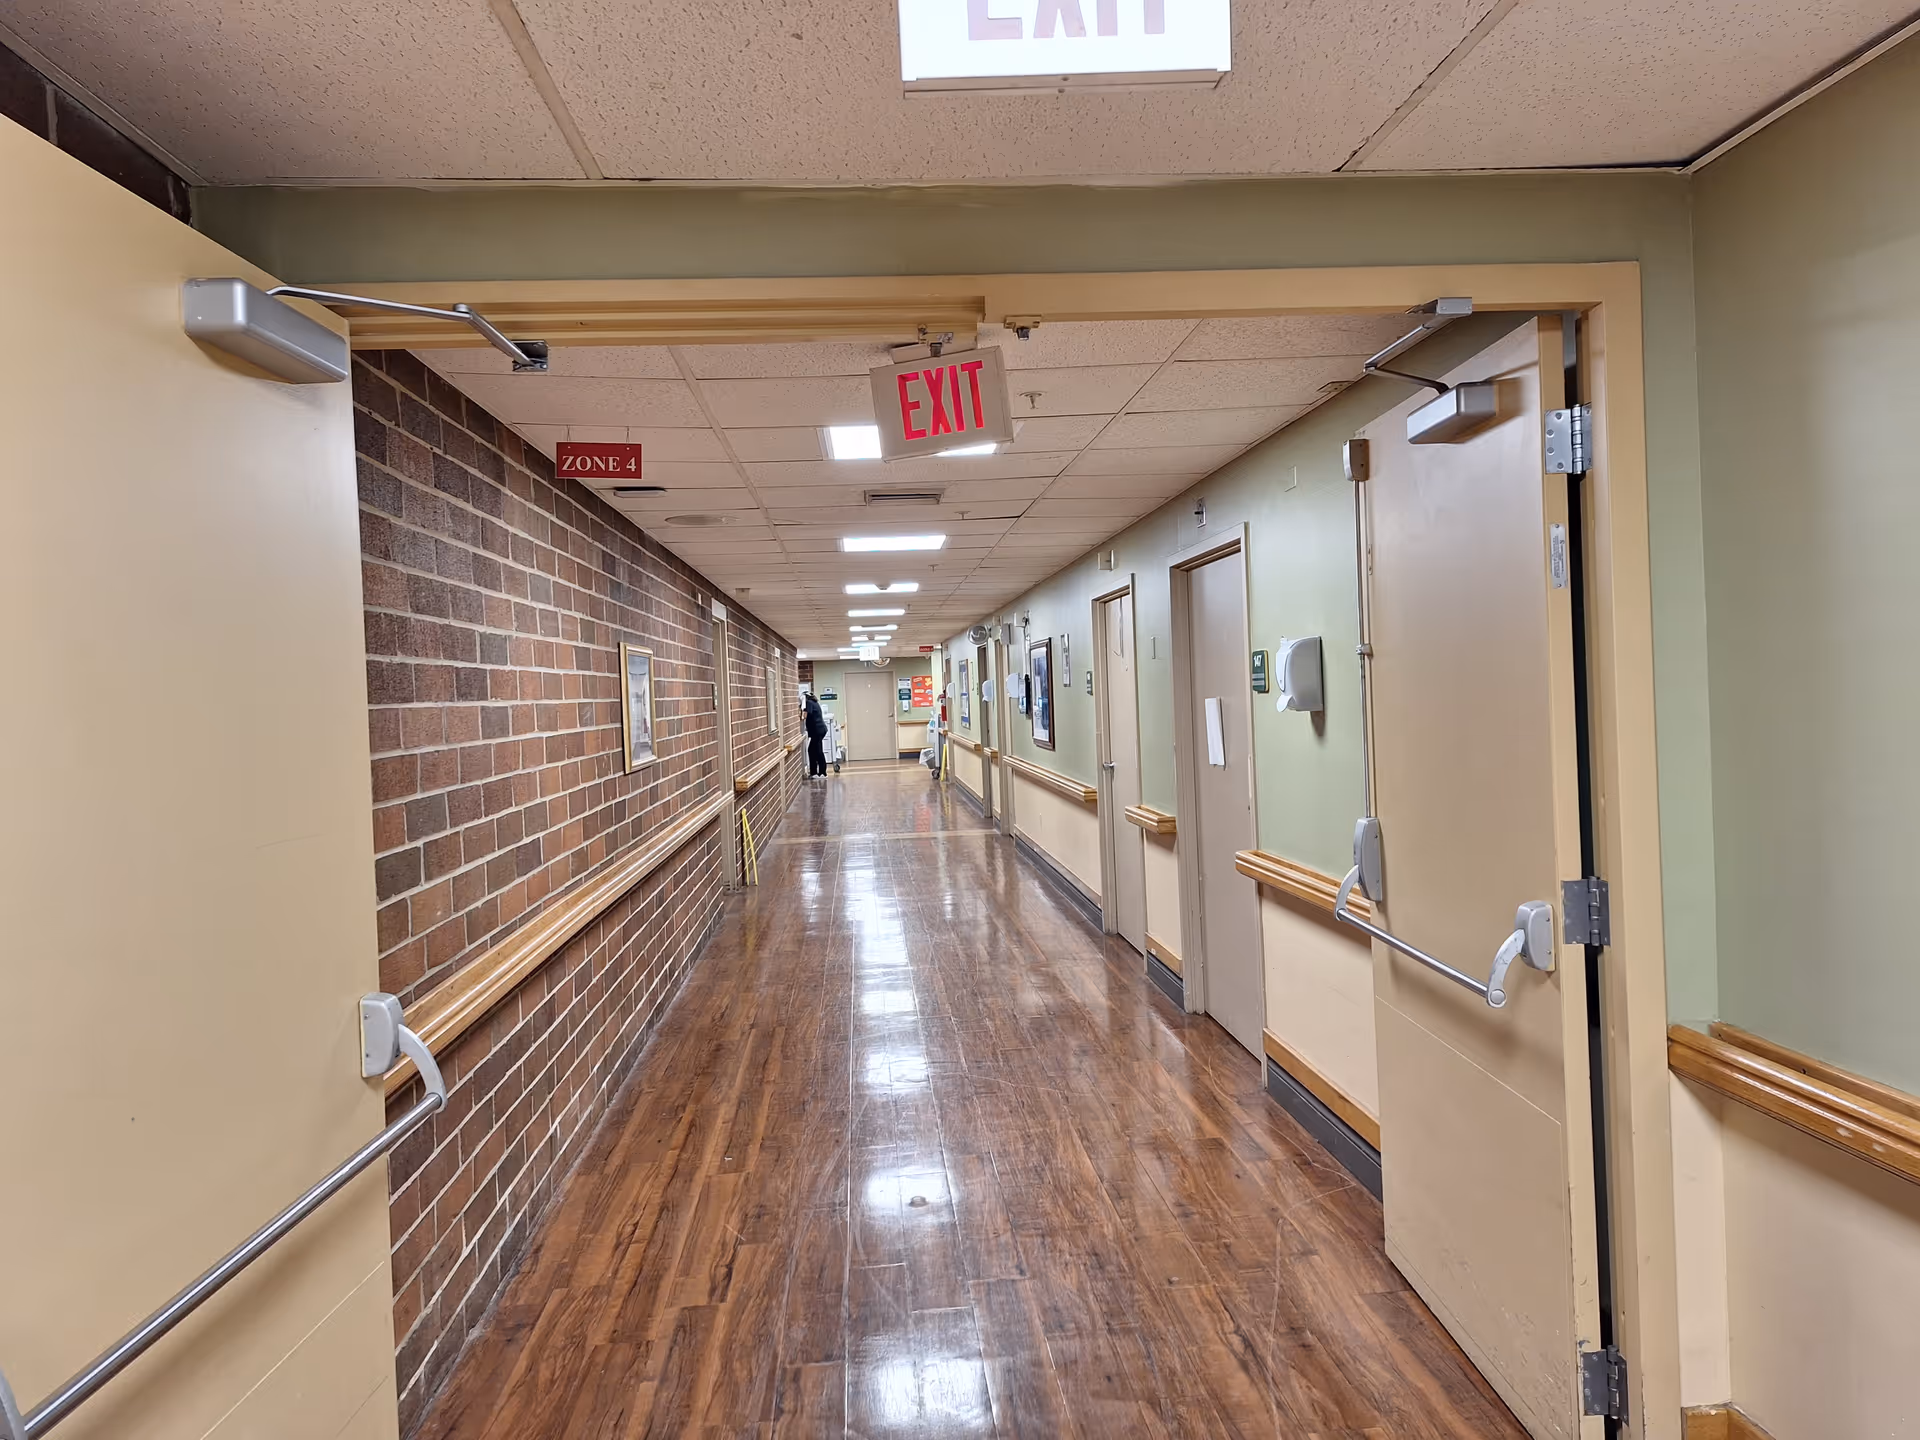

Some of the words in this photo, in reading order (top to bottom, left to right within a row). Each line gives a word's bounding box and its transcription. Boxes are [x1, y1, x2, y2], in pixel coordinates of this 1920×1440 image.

[896, 360, 984, 441] EXIT
[561, 455, 620, 472] ZONE
[626, 457, 636, 472] 4
